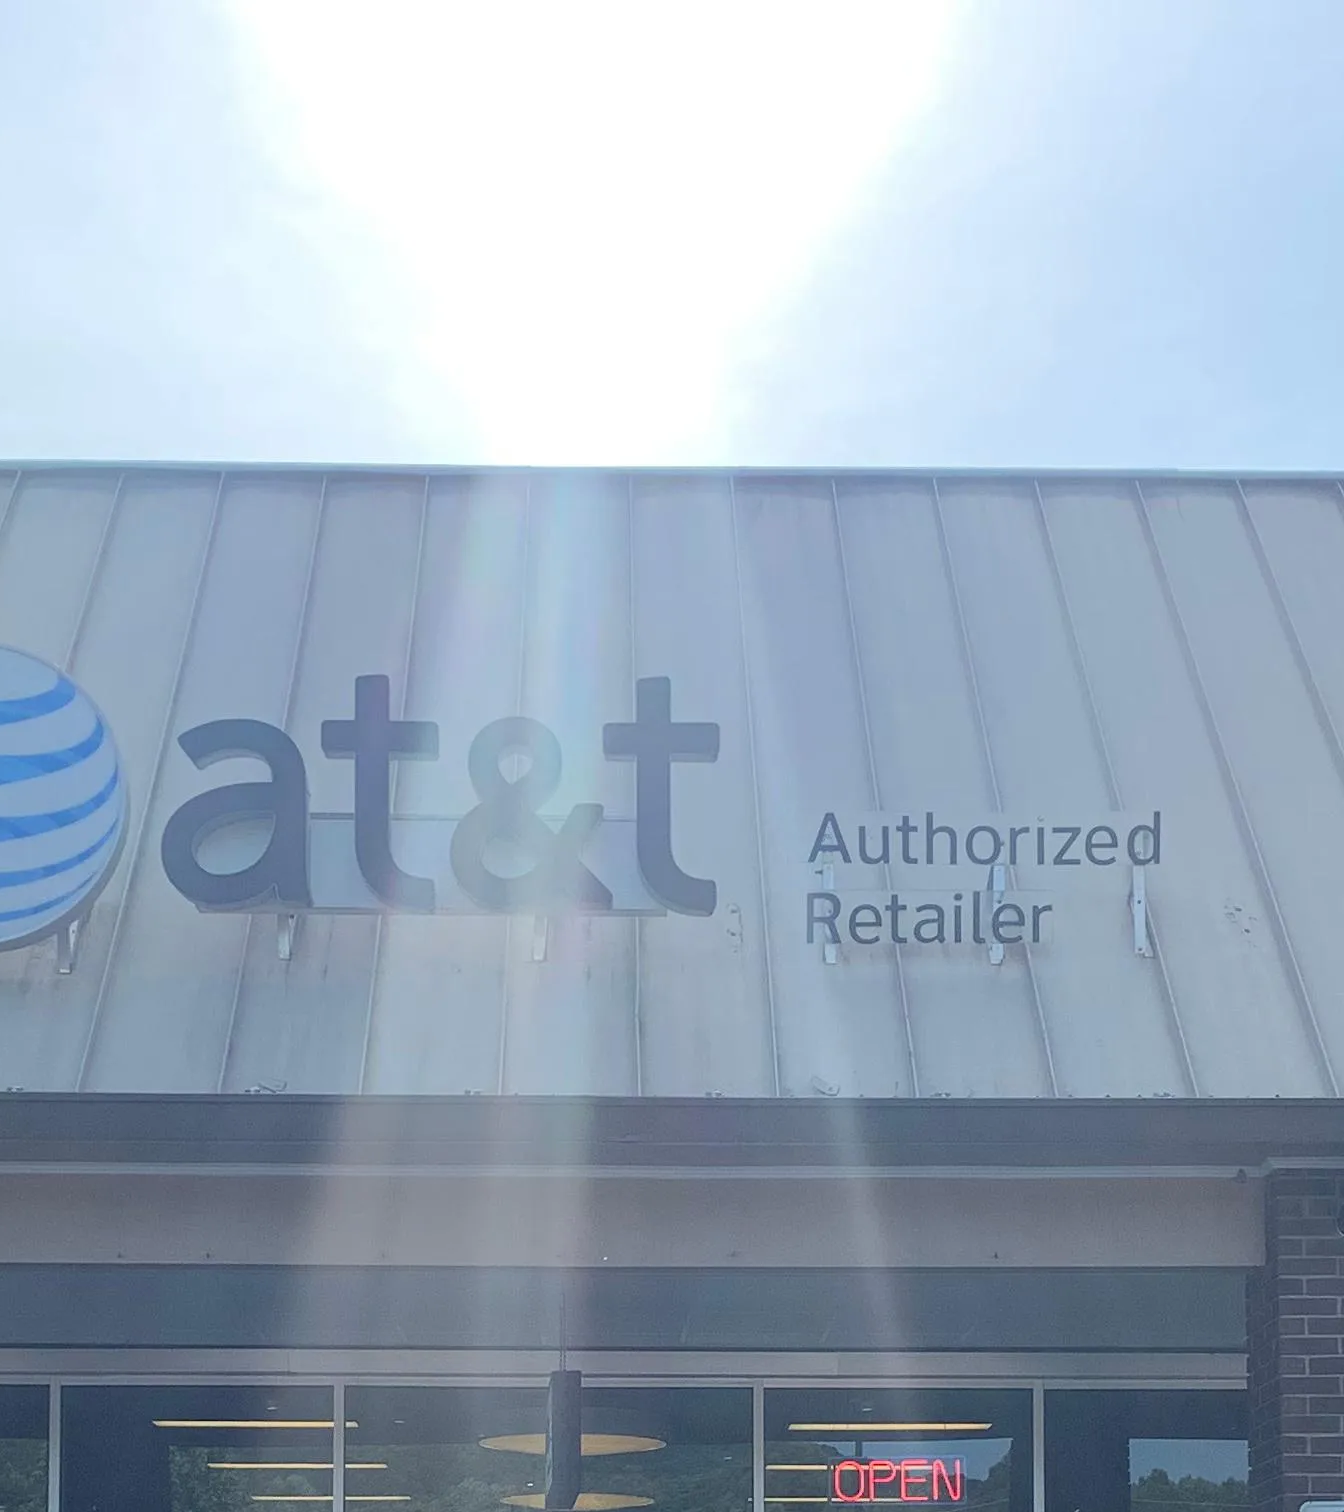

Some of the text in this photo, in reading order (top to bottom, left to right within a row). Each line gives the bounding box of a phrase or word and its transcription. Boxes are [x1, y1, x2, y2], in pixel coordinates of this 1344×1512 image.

[160, 673, 720, 917] at&t
[807, 810, 1162, 866] Authorized
[805, 890, 1054, 945] Retailer
[833, 1458, 962, 1503] OPEN
